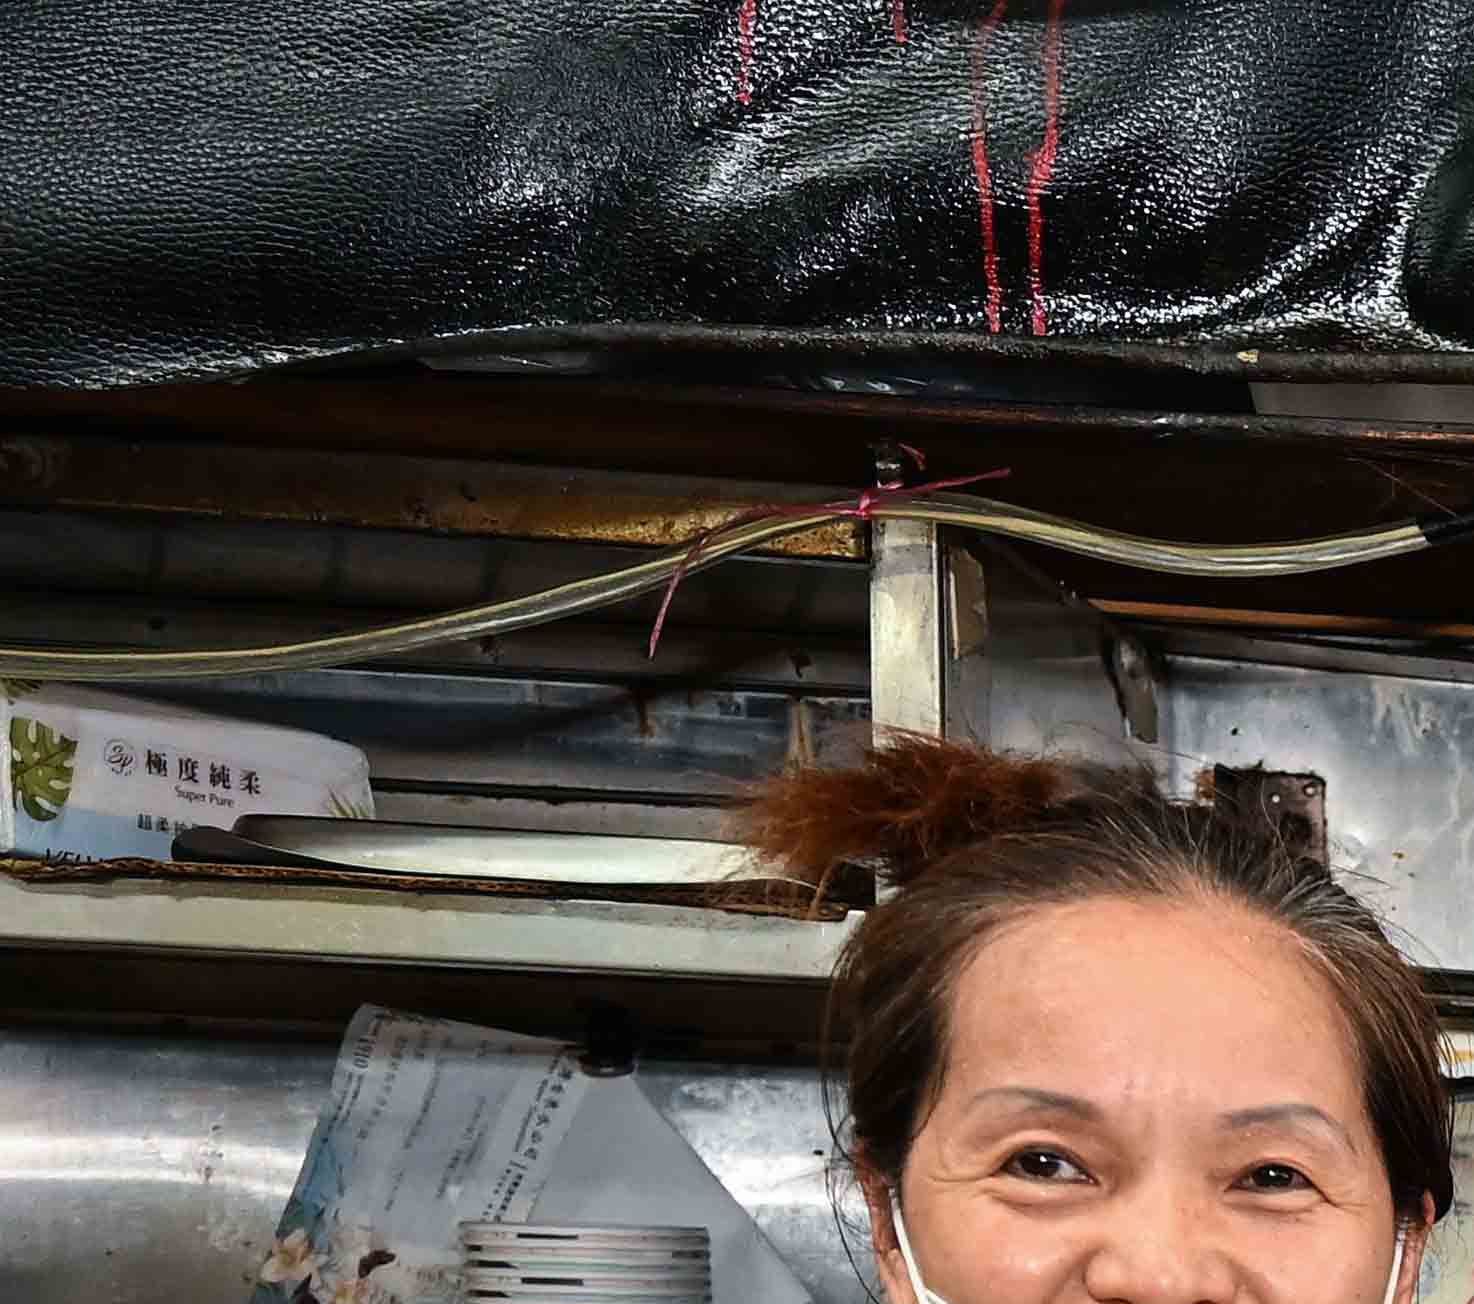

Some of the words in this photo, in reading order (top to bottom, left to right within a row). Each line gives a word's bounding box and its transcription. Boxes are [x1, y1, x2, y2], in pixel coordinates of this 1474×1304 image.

[145, 748, 262, 796] 極度純柔
[174, 784, 206, 803] Super
[209, 792, 236, 808] Pure
